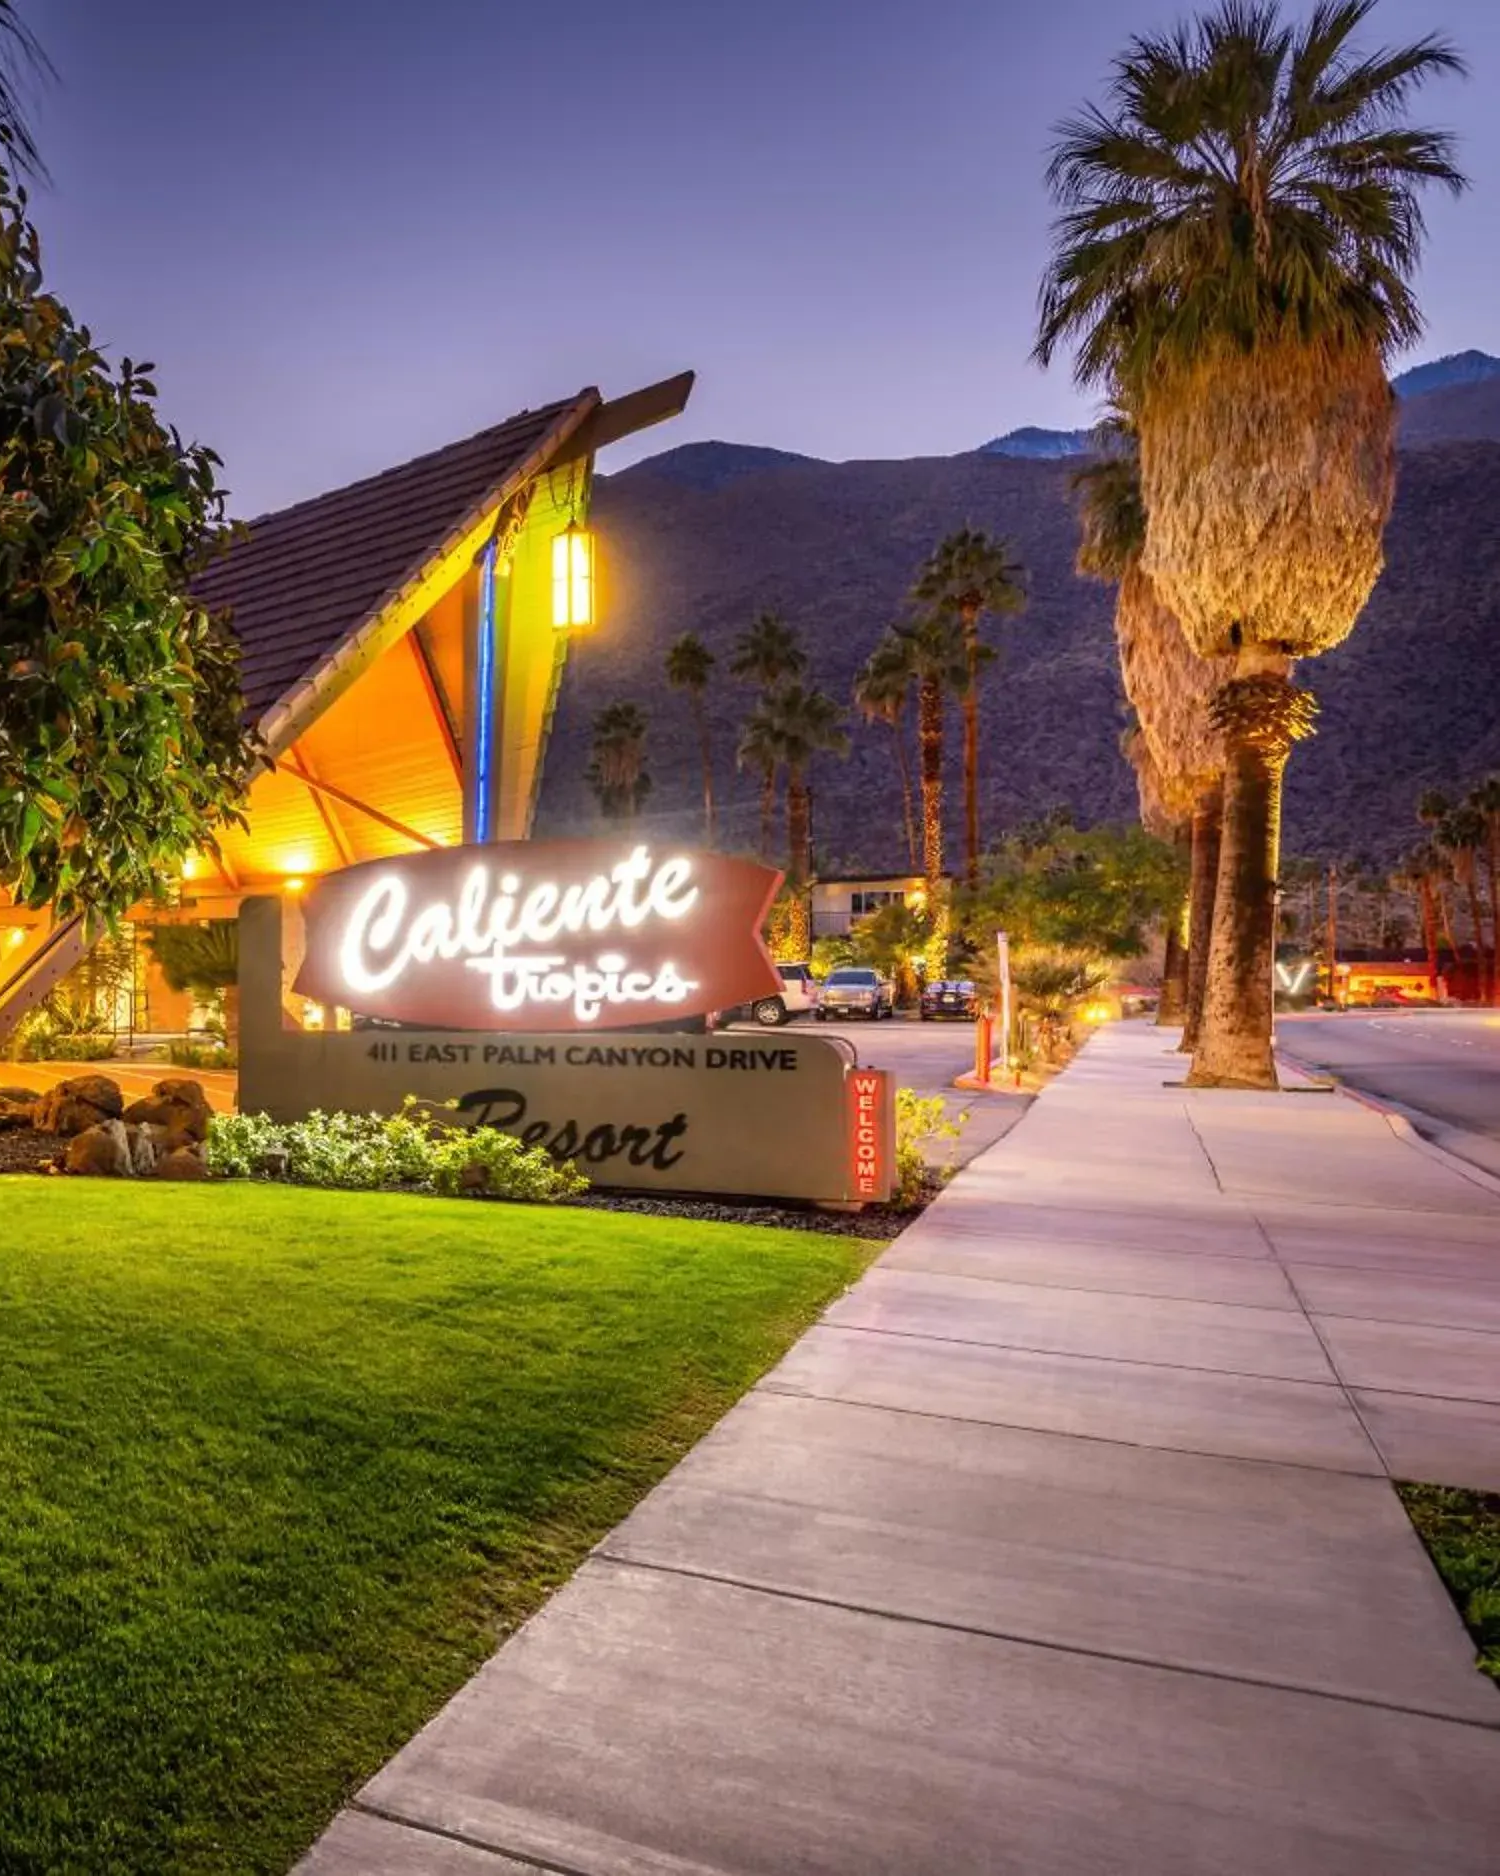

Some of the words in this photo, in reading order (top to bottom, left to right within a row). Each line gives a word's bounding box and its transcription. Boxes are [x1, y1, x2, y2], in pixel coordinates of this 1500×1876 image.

[340, 845, 699, 993] Caliente
[367, 1042, 398, 1063] 411
[409, 1043, 477, 1063] EAST
[483, 1045, 556, 1066] PALM
[565, 1046, 697, 1069] CANYON
[705, 1049, 798, 1070] DRIVE
[457, 1088, 688, 1170] Resort
[855, 1078, 877, 1193] WELCOME
